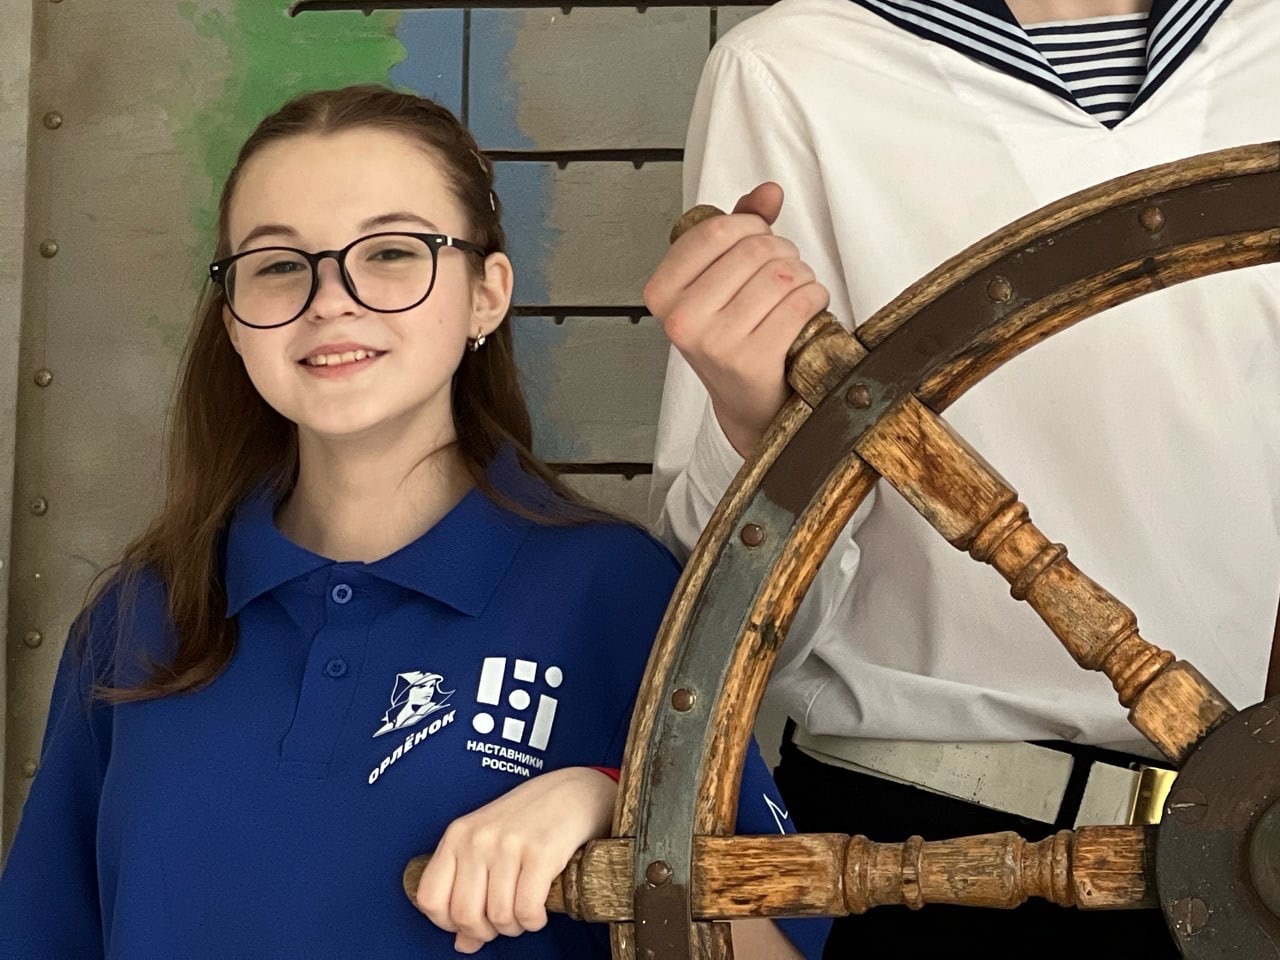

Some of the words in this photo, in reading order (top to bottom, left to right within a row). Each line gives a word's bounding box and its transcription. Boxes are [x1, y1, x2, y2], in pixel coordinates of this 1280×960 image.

[368, 709, 456, 785] ОРЛЁНОК
[466, 740, 544, 770] НАСТАВНИКИ
[482, 756, 530, 777] РОССИИ
